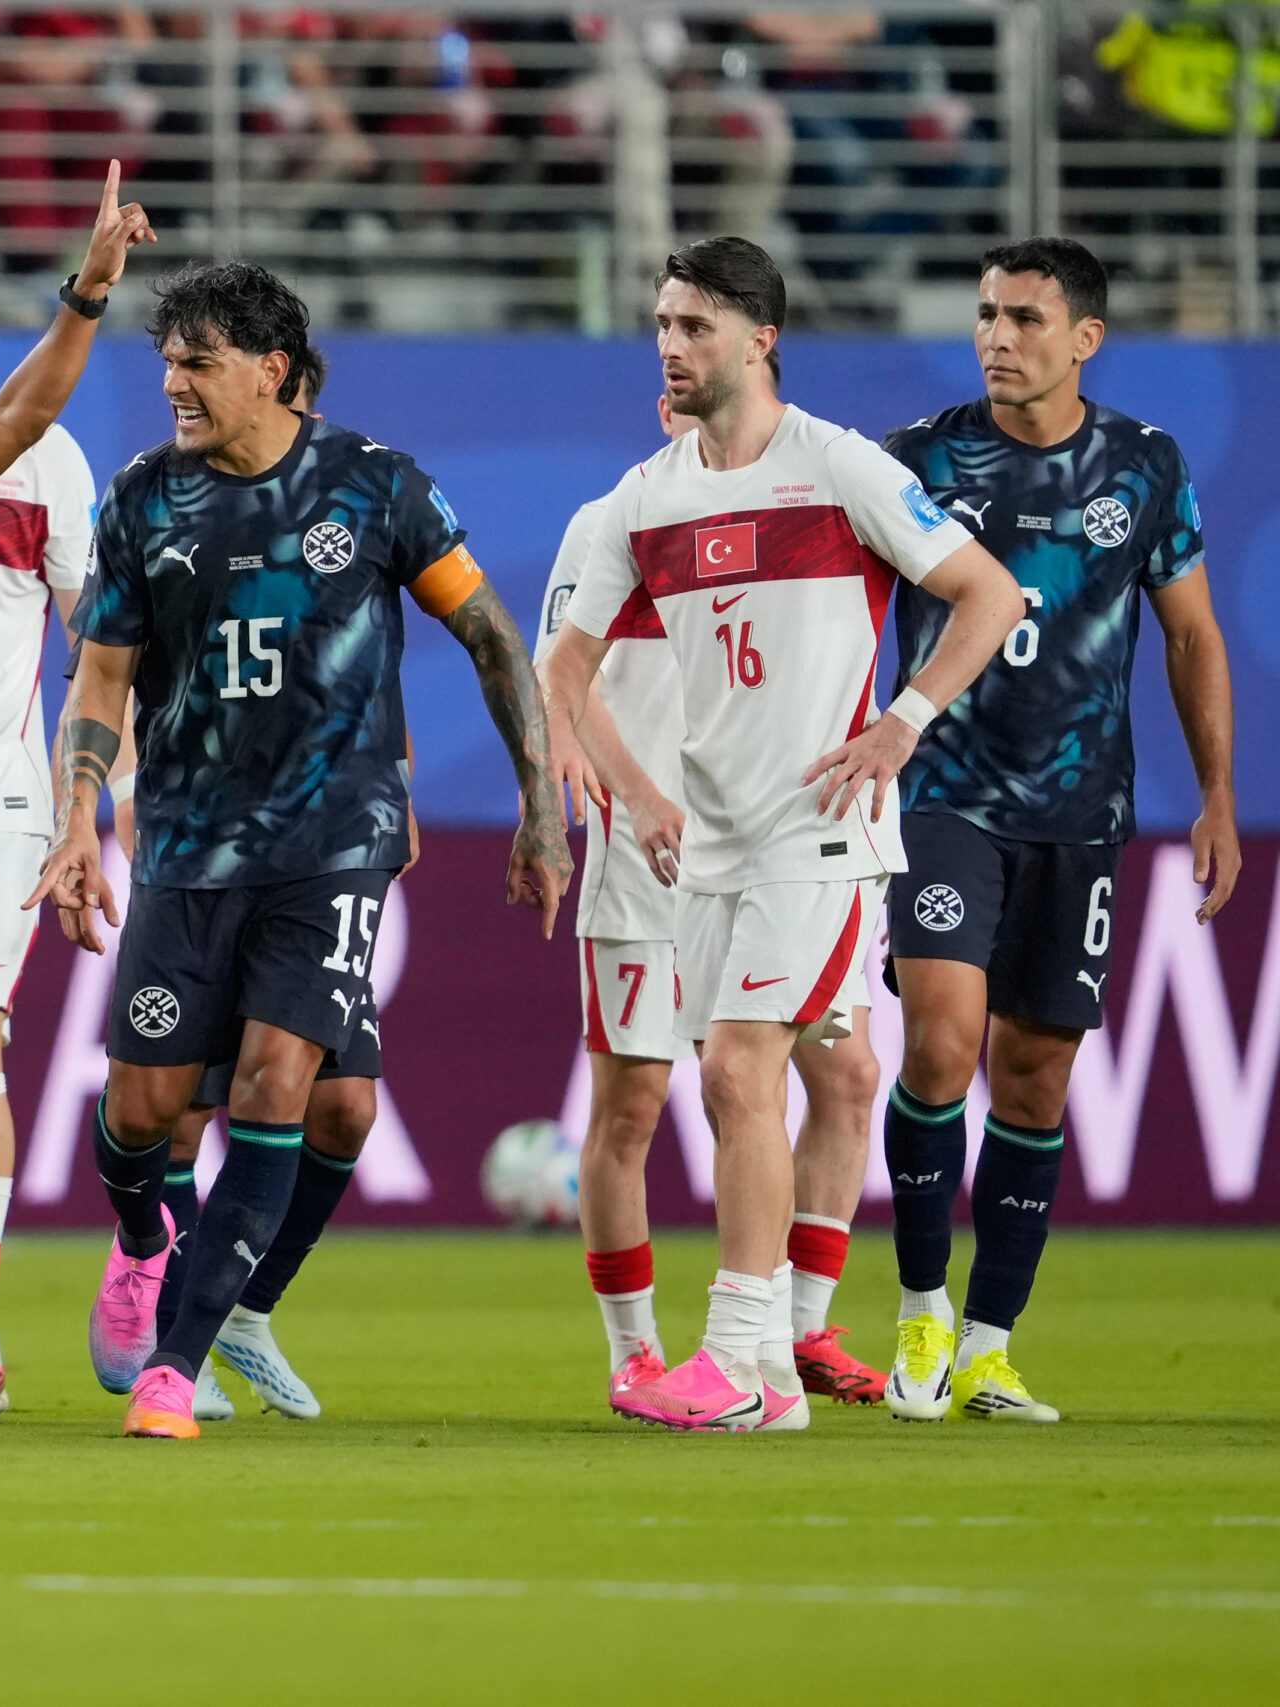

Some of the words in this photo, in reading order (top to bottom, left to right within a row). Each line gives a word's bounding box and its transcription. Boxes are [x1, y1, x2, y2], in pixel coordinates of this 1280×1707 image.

[1100, 501, 1117, 511] APF
[320, 526, 338, 535] APF
[1003, 587, 1043, 667] 6
[217, 616, 285, 699] 15
[714, 620, 767, 692] 16
[931, 888, 949, 897] APF
[322, 893, 380, 978] 15
[1083, 876, 1113, 957] 6
[146, 990, 163, 1000] APF
[618, 963, 648, 1030] 7
[897, 1170, 943, 1185] APF
[999, 1195, 1049, 1213] APF
